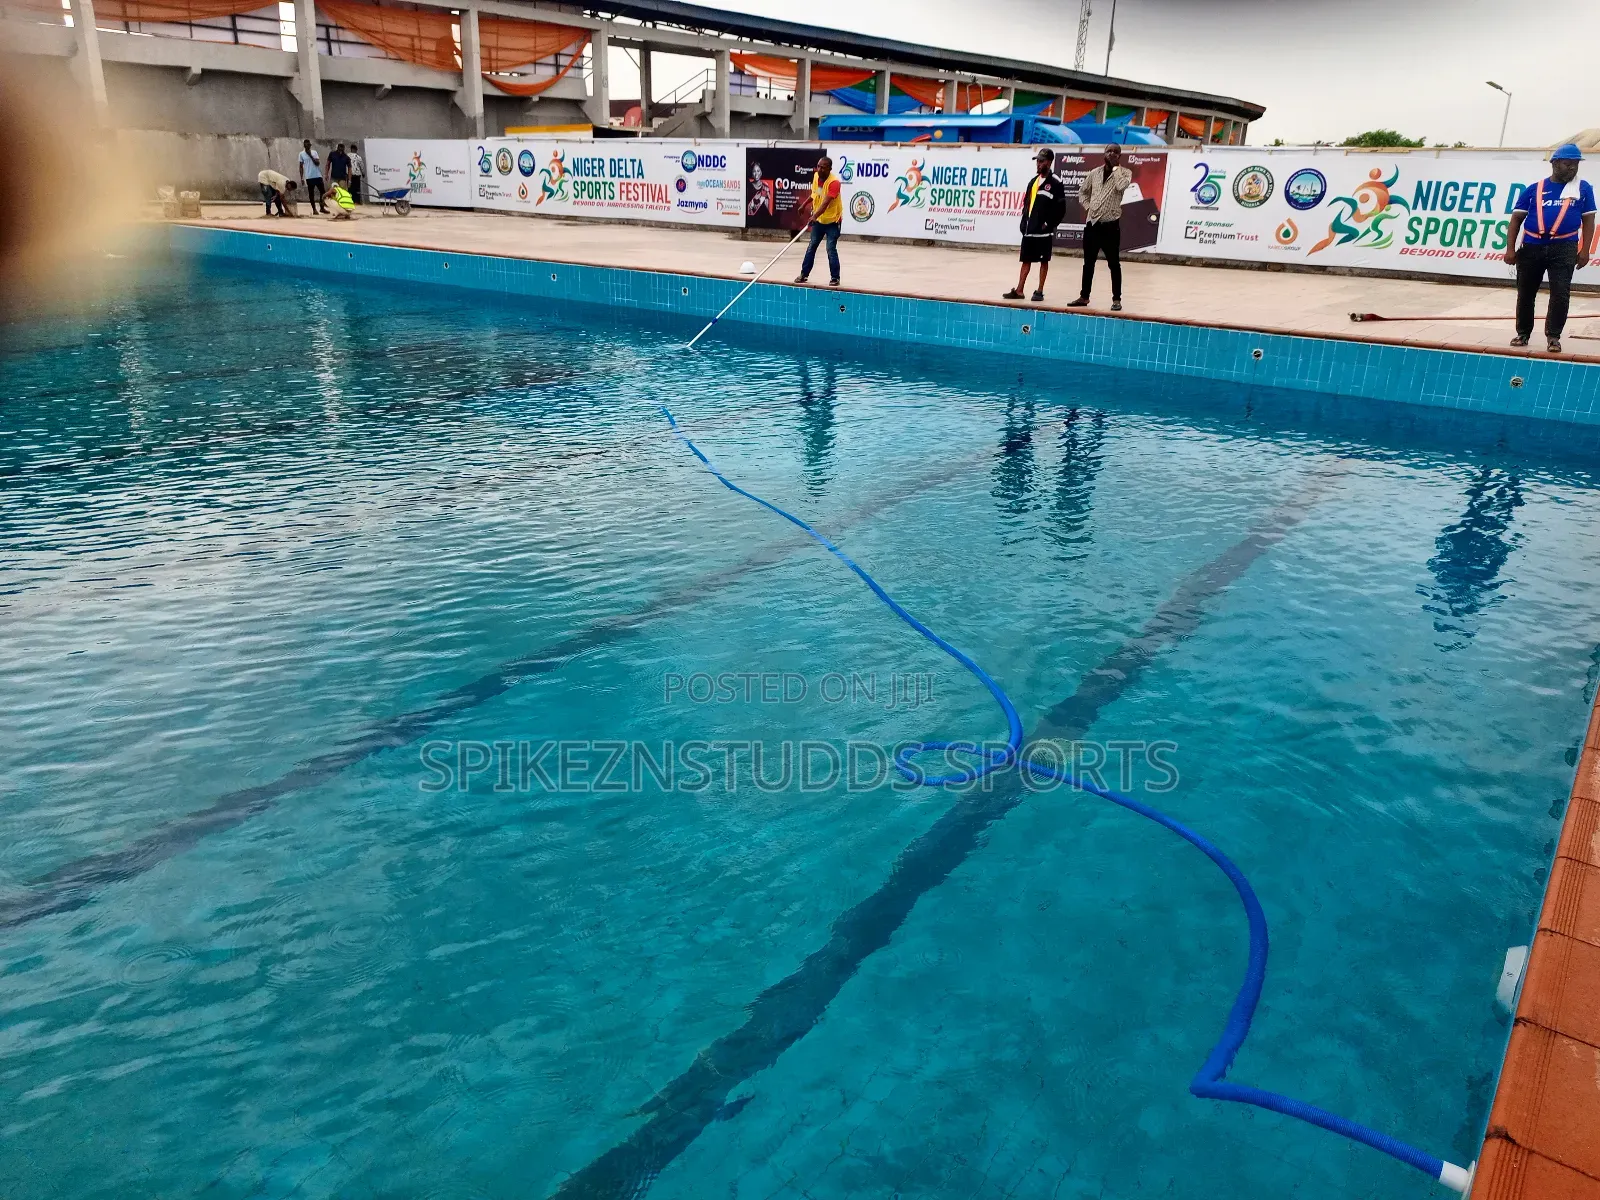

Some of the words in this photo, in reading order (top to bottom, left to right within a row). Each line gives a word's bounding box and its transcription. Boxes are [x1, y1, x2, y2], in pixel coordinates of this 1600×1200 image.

[572, 157, 605, 178] NIGER
[609, 158, 645, 179] DELTA
[697, 155, 727, 168] NDDC
[857, 163, 889, 177] NDDC
[932, 166, 967, 186] NIGER
[971, 167, 1008, 187] DELTA
[573, 180, 615, 201] SPORTS
[619, 182, 671, 204] FESTIVAL
[790, 181, 813, 190] Premi
[930, 188, 975, 208] SPORTS
[979, 190, 1026, 209] FESTIVA
[1412, 180, 1497, 214] NIGER
[677, 198, 708, 210] Jazmyne
[934, 222, 975, 231] PremiumTrust
[1204, 220, 1234, 228] Sponsor
[1199, 230, 1259, 242] PremiumTrust
[1405, 216, 1508, 250] SPORTS
[1399, 247, 1455, 258] BEYOND
